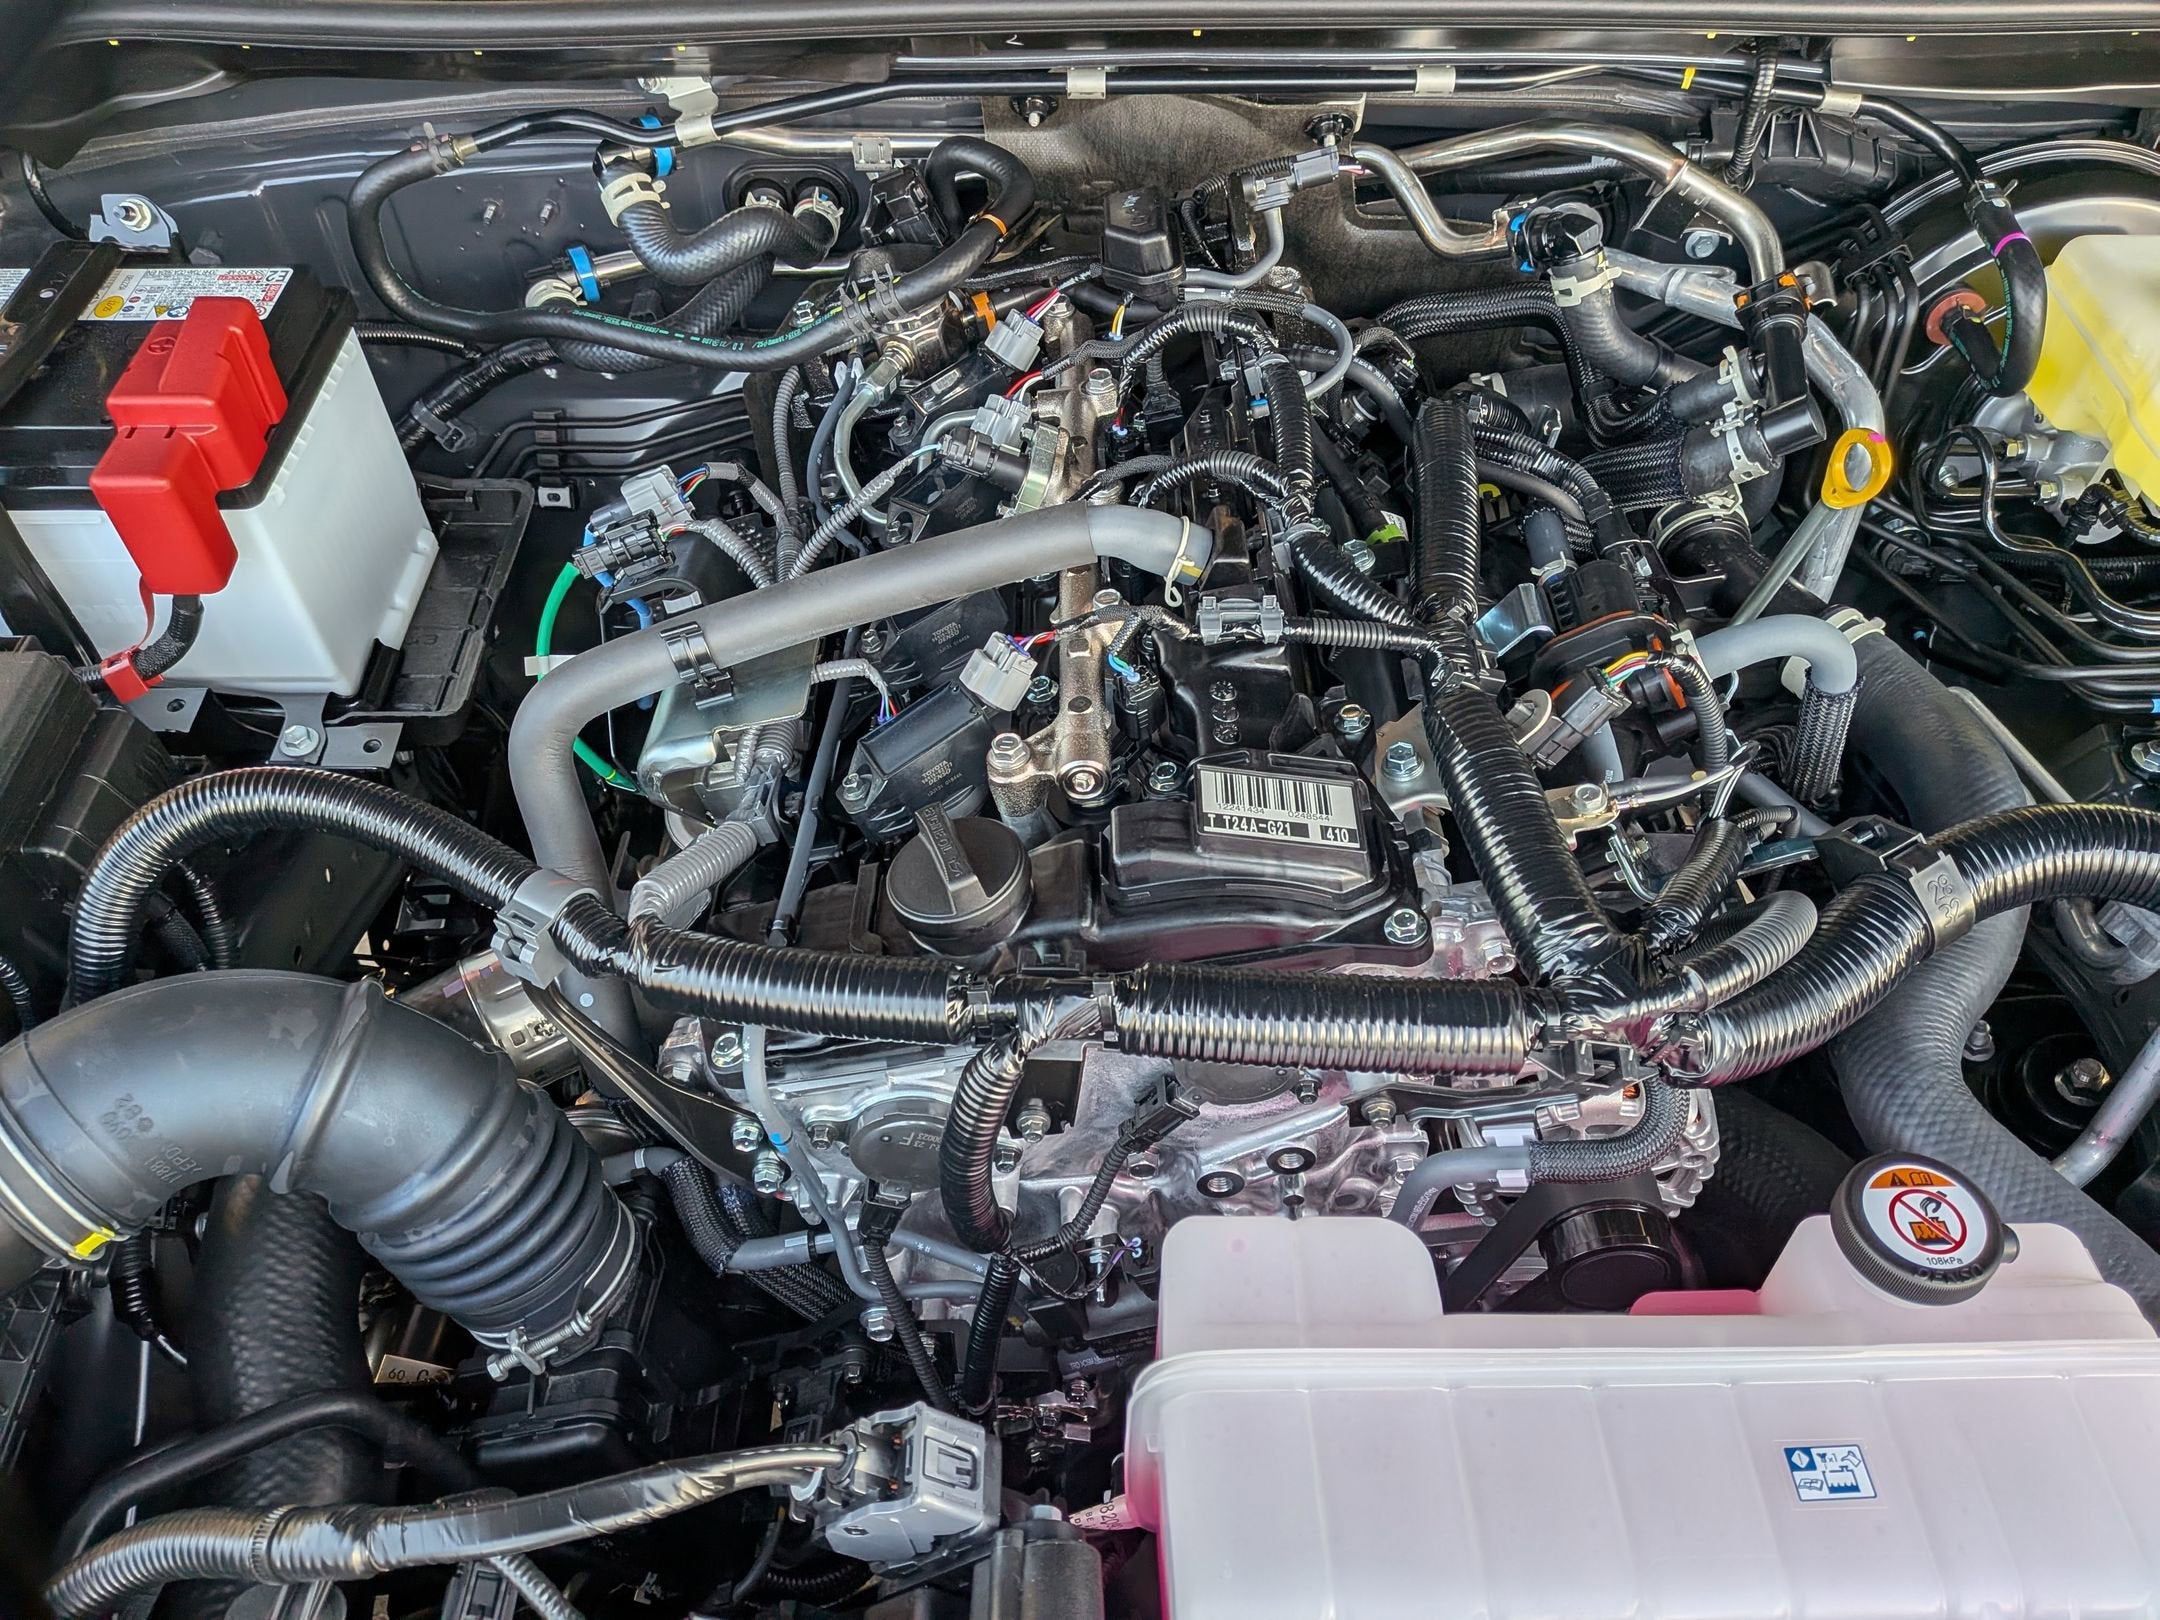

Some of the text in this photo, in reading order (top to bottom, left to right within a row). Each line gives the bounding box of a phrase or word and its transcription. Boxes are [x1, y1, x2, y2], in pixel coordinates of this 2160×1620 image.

[264, 270, 289, 282] E2
[921, 760, 948, 777] TOYOTA
[1217, 803, 1265, 814] 12241434
[1287, 811, 1330, 821] 0248544
[1223, 815, 1291, 836] T24A-G21
[1327, 827, 1349, 842] 410
[1927, 873, 1953, 905] 28
[1938, 897, 1965, 928] 32
[899, 1132, 914, 1146] F
[1926, 1256, 1964, 1265] 108kPa
